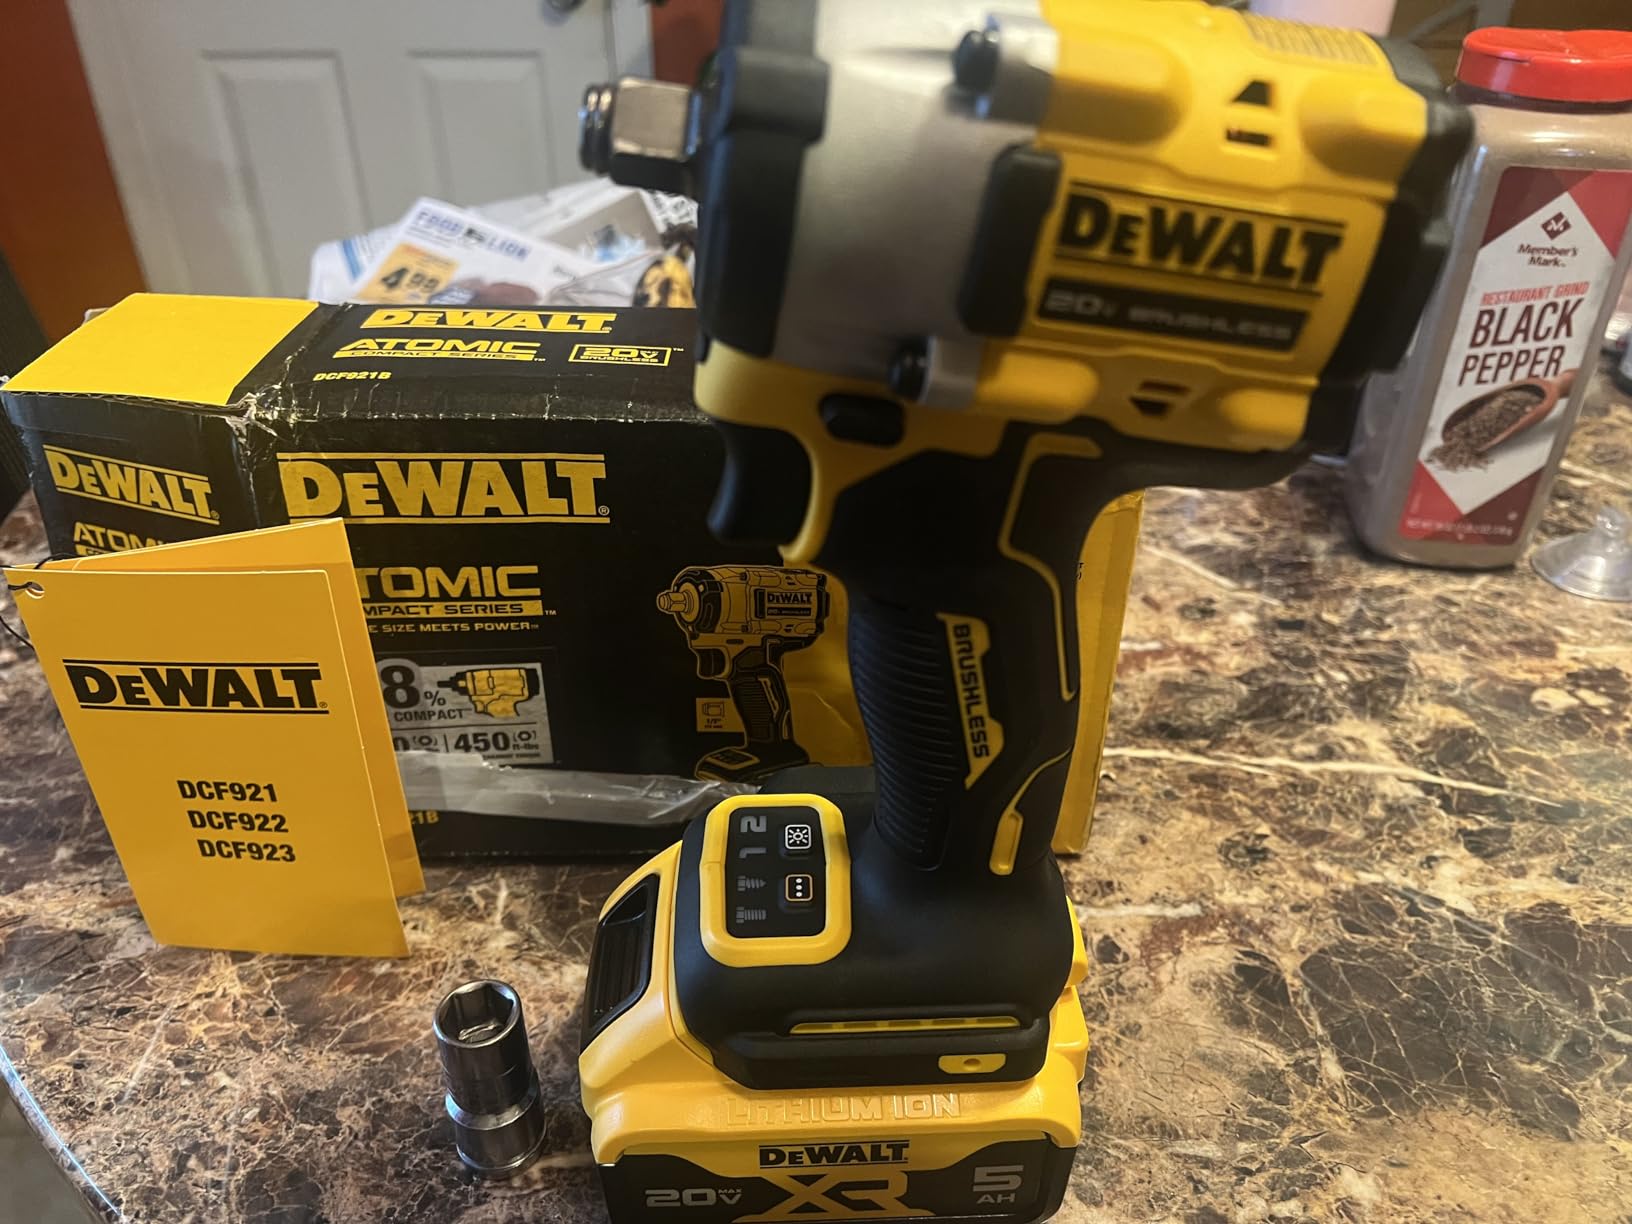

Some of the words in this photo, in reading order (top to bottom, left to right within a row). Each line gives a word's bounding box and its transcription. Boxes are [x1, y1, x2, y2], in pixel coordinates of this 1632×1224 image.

[1057, 194, 1344, 285] DEWALT
[1480, 285, 1551, 305] RESTAURANT
[1553, 280, 1590, 299] GRIND
[365, 309, 617, 331] DEWALT
[1469, 298, 1584, 349] BLACK
[339, 338, 541, 354] ATOMIC
[352, 350, 436, 358] COMPACT
[312, 371, 392, 381] DCF921B
[1457, 345, 1566, 388] PEPPER
[44, 450, 212, 518] DEWALT
[277, 461, 606, 517] DEWALT
[354, 565, 541, 599] TOMIC
[364, 605, 433, 616] MPACT
[444, 603, 524, 615] SERIES
[382, 623, 416, 633] SIZE
[420, 623, 471, 632] MEETS
[474, 621, 531, 631] POWER
[64, 664, 322, 709] DEWALT
[952, 623, 990, 759] BRUSHLESS
[393, 708, 465, 722] COMPACT
[454, 731, 510, 753] 450
[177, 780, 278, 803] DCF921
[187, 810, 289, 833] DCF922
[197, 839, 296, 863] DCF923
[725, 1097, 884, 1127] LITHIUM
[892, 1092, 962, 1120] ION
[759, 1142, 909, 1167] DEWALT
[973, 1164, 1024, 1193] 5
[732, 1170, 937, 1221] XR
[976, 1192, 1016, 1204] AH
